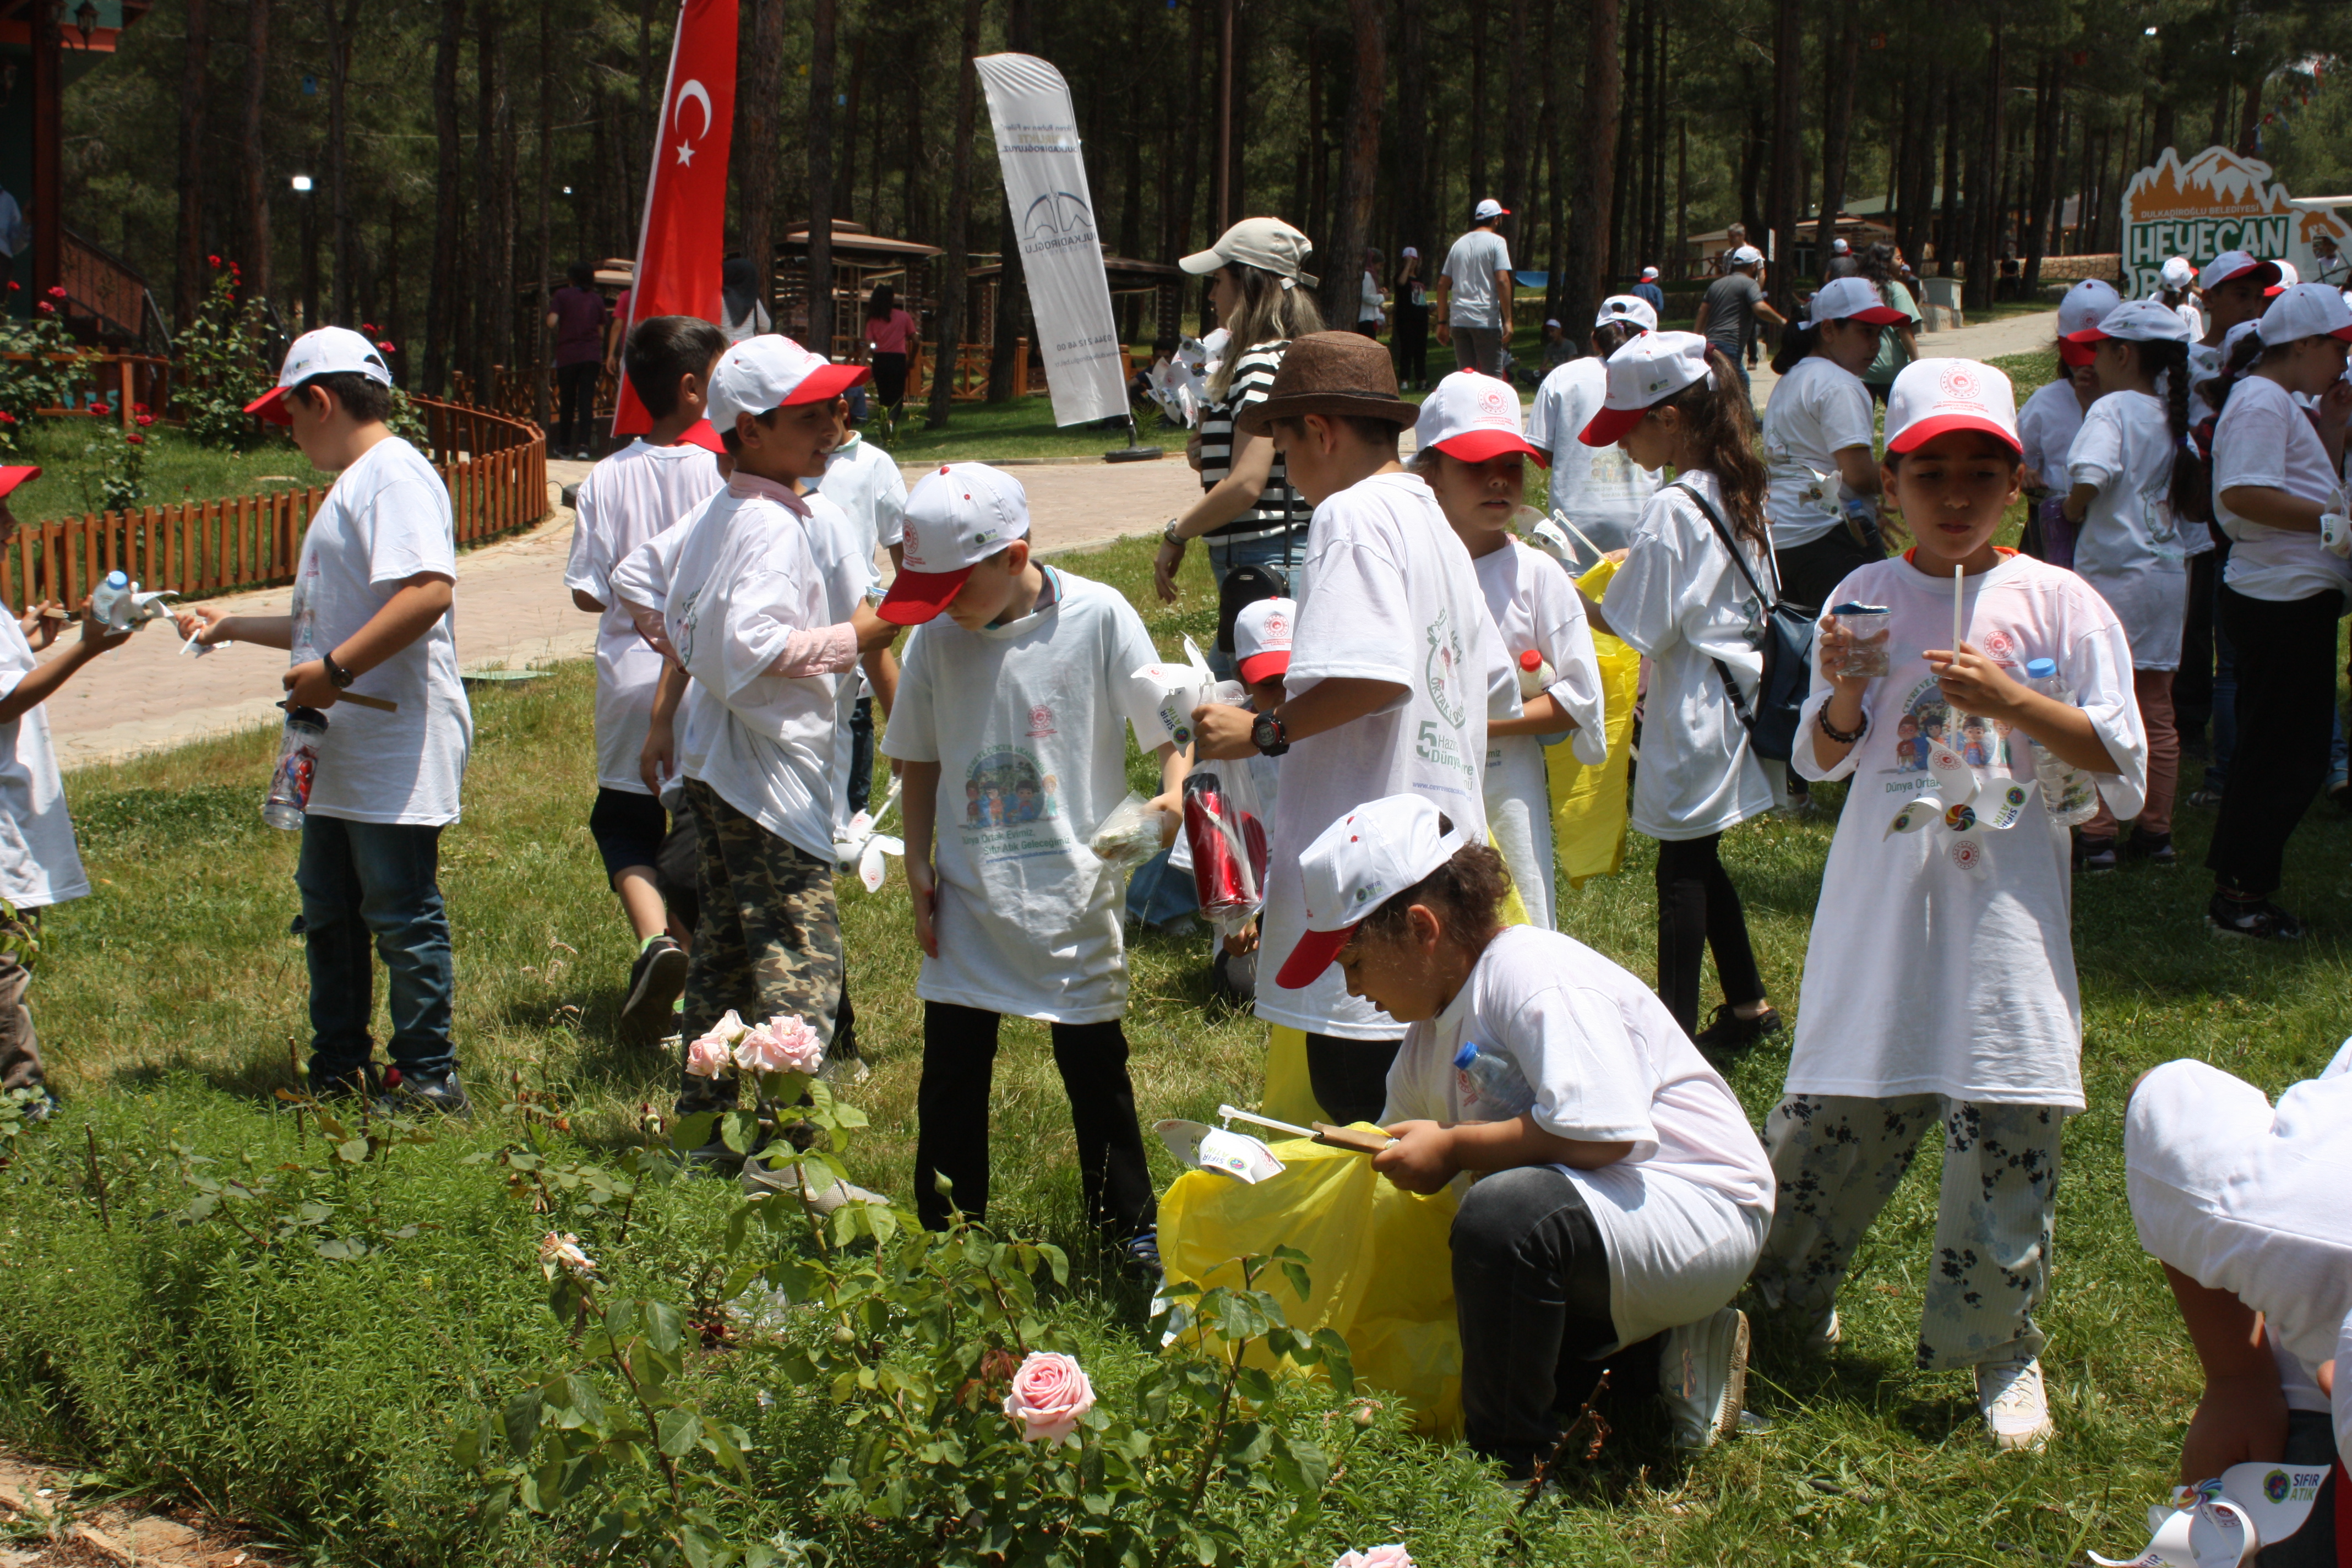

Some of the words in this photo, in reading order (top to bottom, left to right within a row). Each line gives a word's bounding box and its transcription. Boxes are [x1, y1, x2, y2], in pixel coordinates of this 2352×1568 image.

[2141, 206, 2206, 219] DULKADİROĞLU
[2209, 203, 2260, 215] BELEDİYESİ
[2132, 218, 2285, 264] HEYECAN
[1919, 678, 1931, 689] VE
[1160, 709, 1175, 731] SIFIR
[1166, 705, 1183, 725] ATIK
[1415, 720, 1438, 759] 5
[1886, 781, 1913, 793] Dünya
[1992, 803, 2010, 826] ATIK
[1999, 807, 2018, 829] SIFIR
[981, 832, 1004, 843] Ortak
[1006, 827, 1036, 840] Evimiz,
[1365, 880, 1381, 891] SIFIR
[1202, 1153, 1226, 1164] SIFIR
[1205, 1145, 1230, 1158] ATIK
[2293, 1473, 2320, 1487] SIFIR
[2289, 1487, 2317, 1501] ATIK
